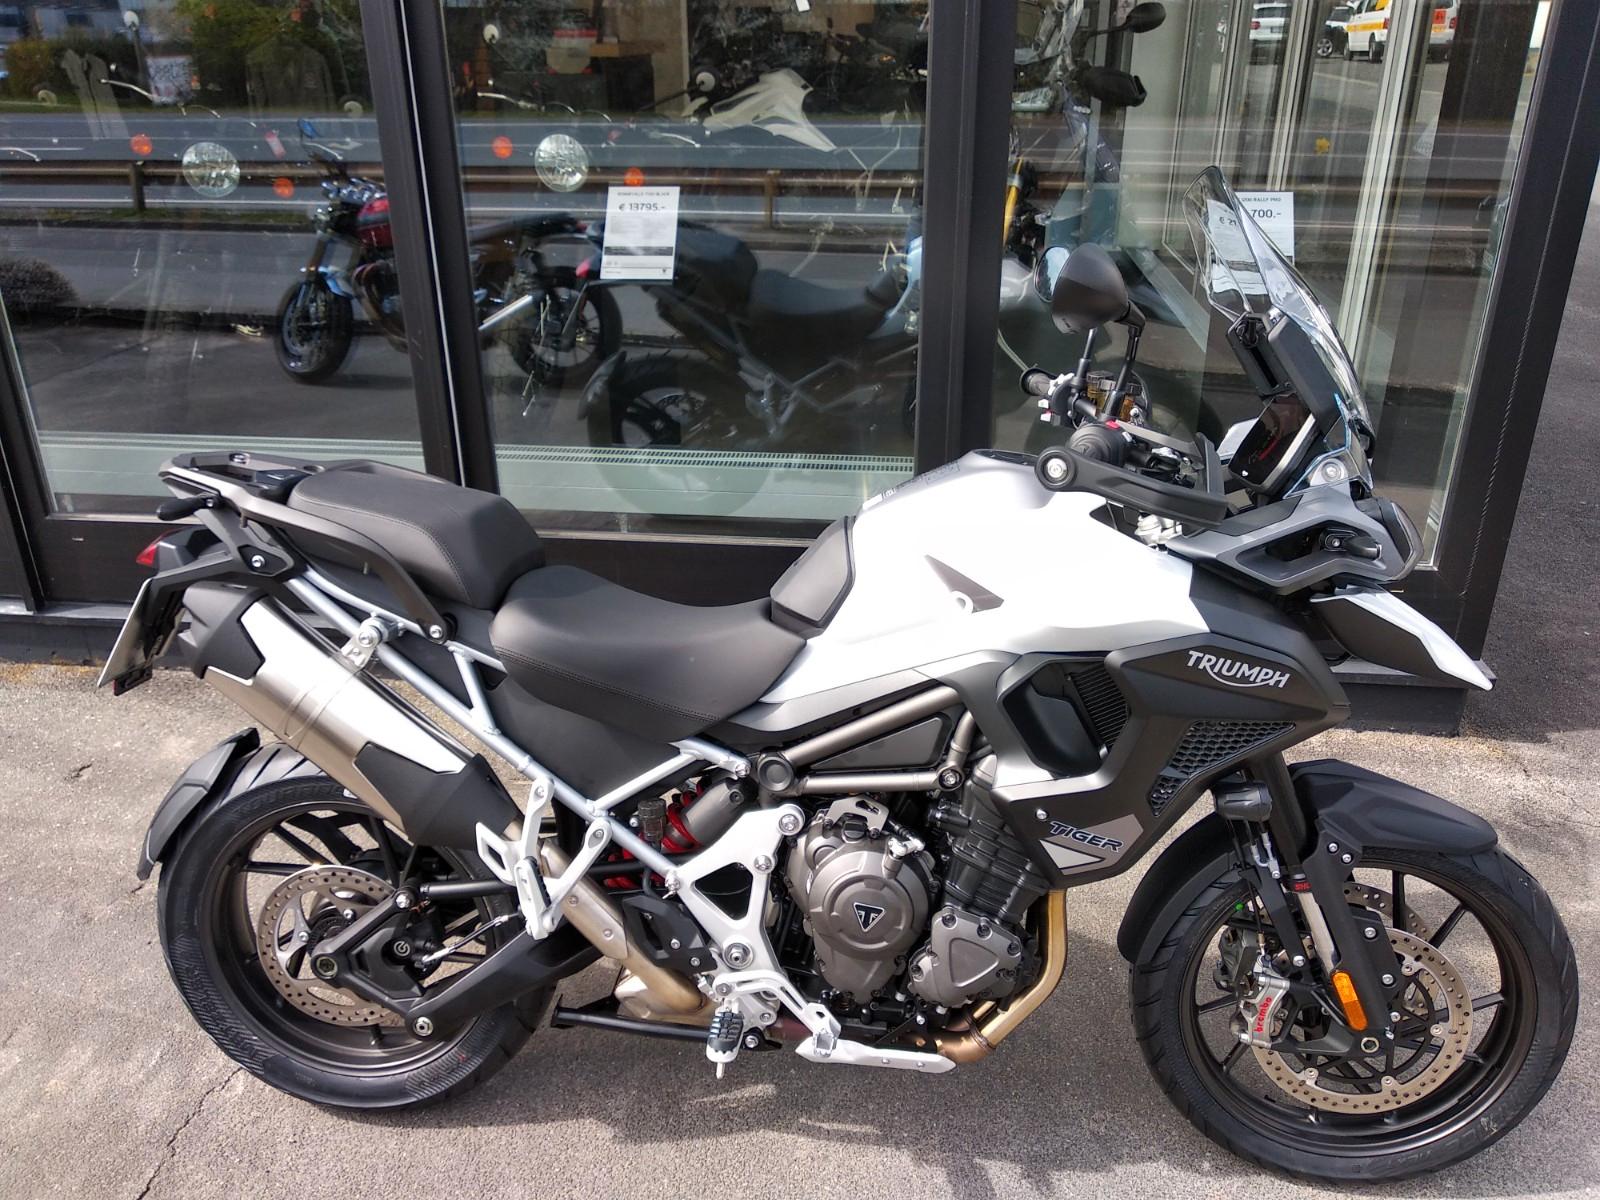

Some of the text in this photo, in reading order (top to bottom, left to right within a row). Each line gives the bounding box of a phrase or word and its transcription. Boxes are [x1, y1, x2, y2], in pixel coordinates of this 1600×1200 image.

[1187, 650, 1291, 688] TRIUMPH
[1050, 820, 1124, 853] TIGER
[1254, 996, 1273, 1033] brembo
